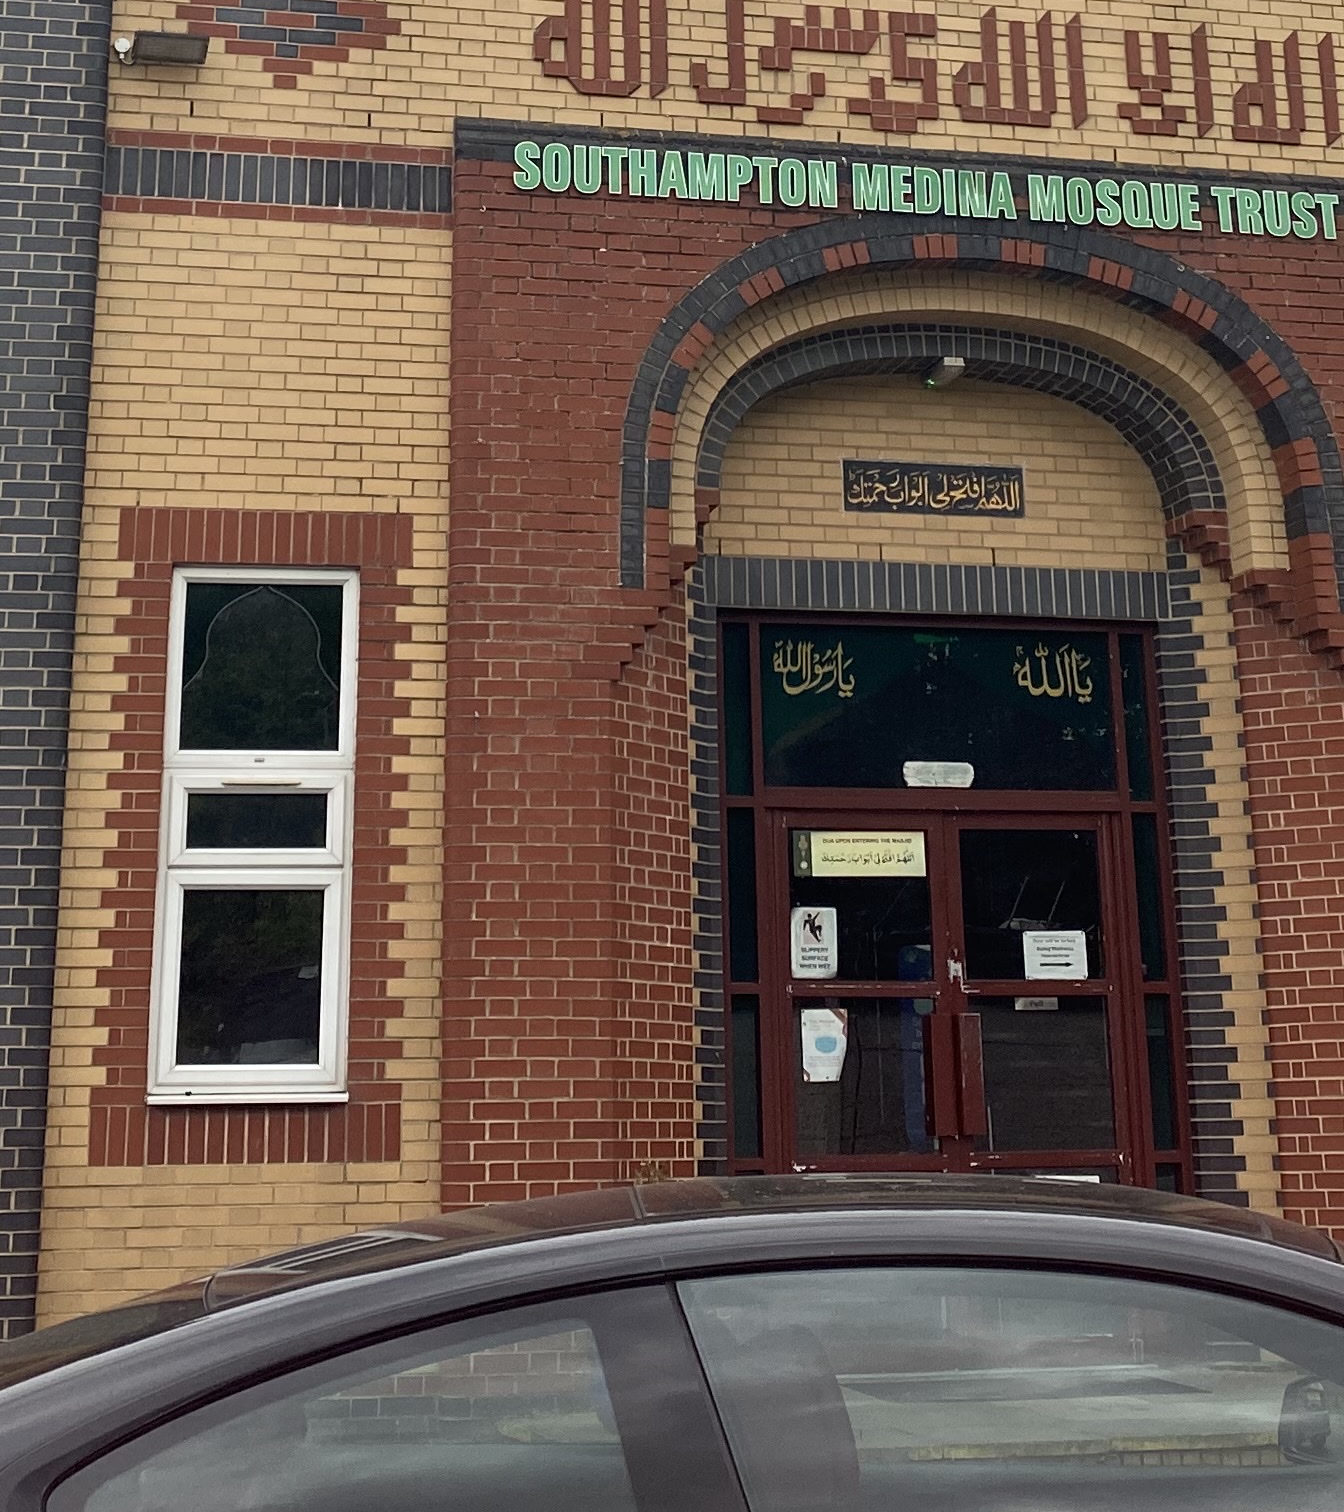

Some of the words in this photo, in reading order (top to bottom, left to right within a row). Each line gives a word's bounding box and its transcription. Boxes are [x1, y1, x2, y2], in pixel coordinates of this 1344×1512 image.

[513, 140, 838, 208] SOUTHAMPTON
[852, 162, 1017, 219] MEDINA
[1027, 174, 1202, 231] MOSQUE
[1210, 186, 1339, 240] TRUST
